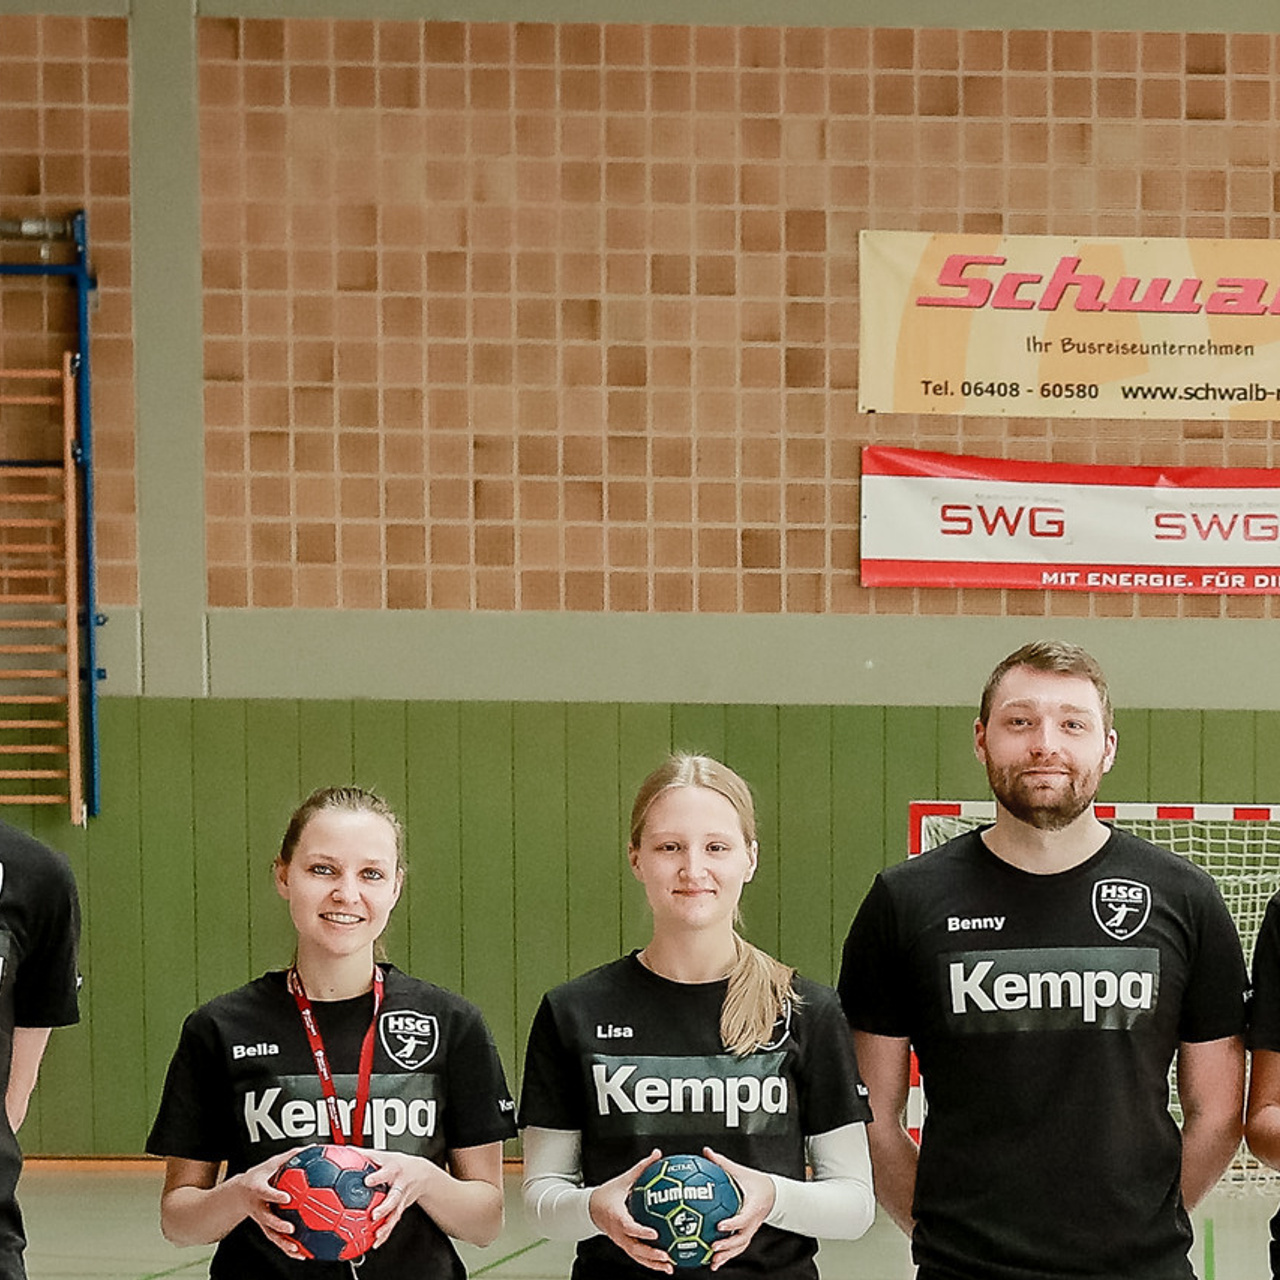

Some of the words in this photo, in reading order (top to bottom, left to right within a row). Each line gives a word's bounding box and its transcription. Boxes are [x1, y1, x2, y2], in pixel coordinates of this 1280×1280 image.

[1026, 336, 1052, 354] Ihr
[1061, 337, 1254, 356] Busreiseunternehmen
[921, 380, 954, 397] Tel.
[961, 381, 1020, 397] 06408
[1040, 382, 1099, 398] 60580
[940, 504, 1065, 537] SWG
[1154, 512, 1280, 541] SWG
[1042, 571, 1078, 585] MIT
[1087, 572, 1193, 588] ENERGIE.
[1202, 571, 1246, 588] FÜR
[1101, 885, 1143, 899] HSG
[947, 915, 1006, 931] Benny
[949, 960, 1153, 1023] Kempa
[388, 1016, 431, 1033] HSG
[597, 1024, 633, 1039] Lisa
[232, 1041, 279, 1060] Bella
[592, 1064, 788, 1127] Kempa
[245, 1087, 438, 1150] Kempa
[647, 1182, 713, 1206] hummel
